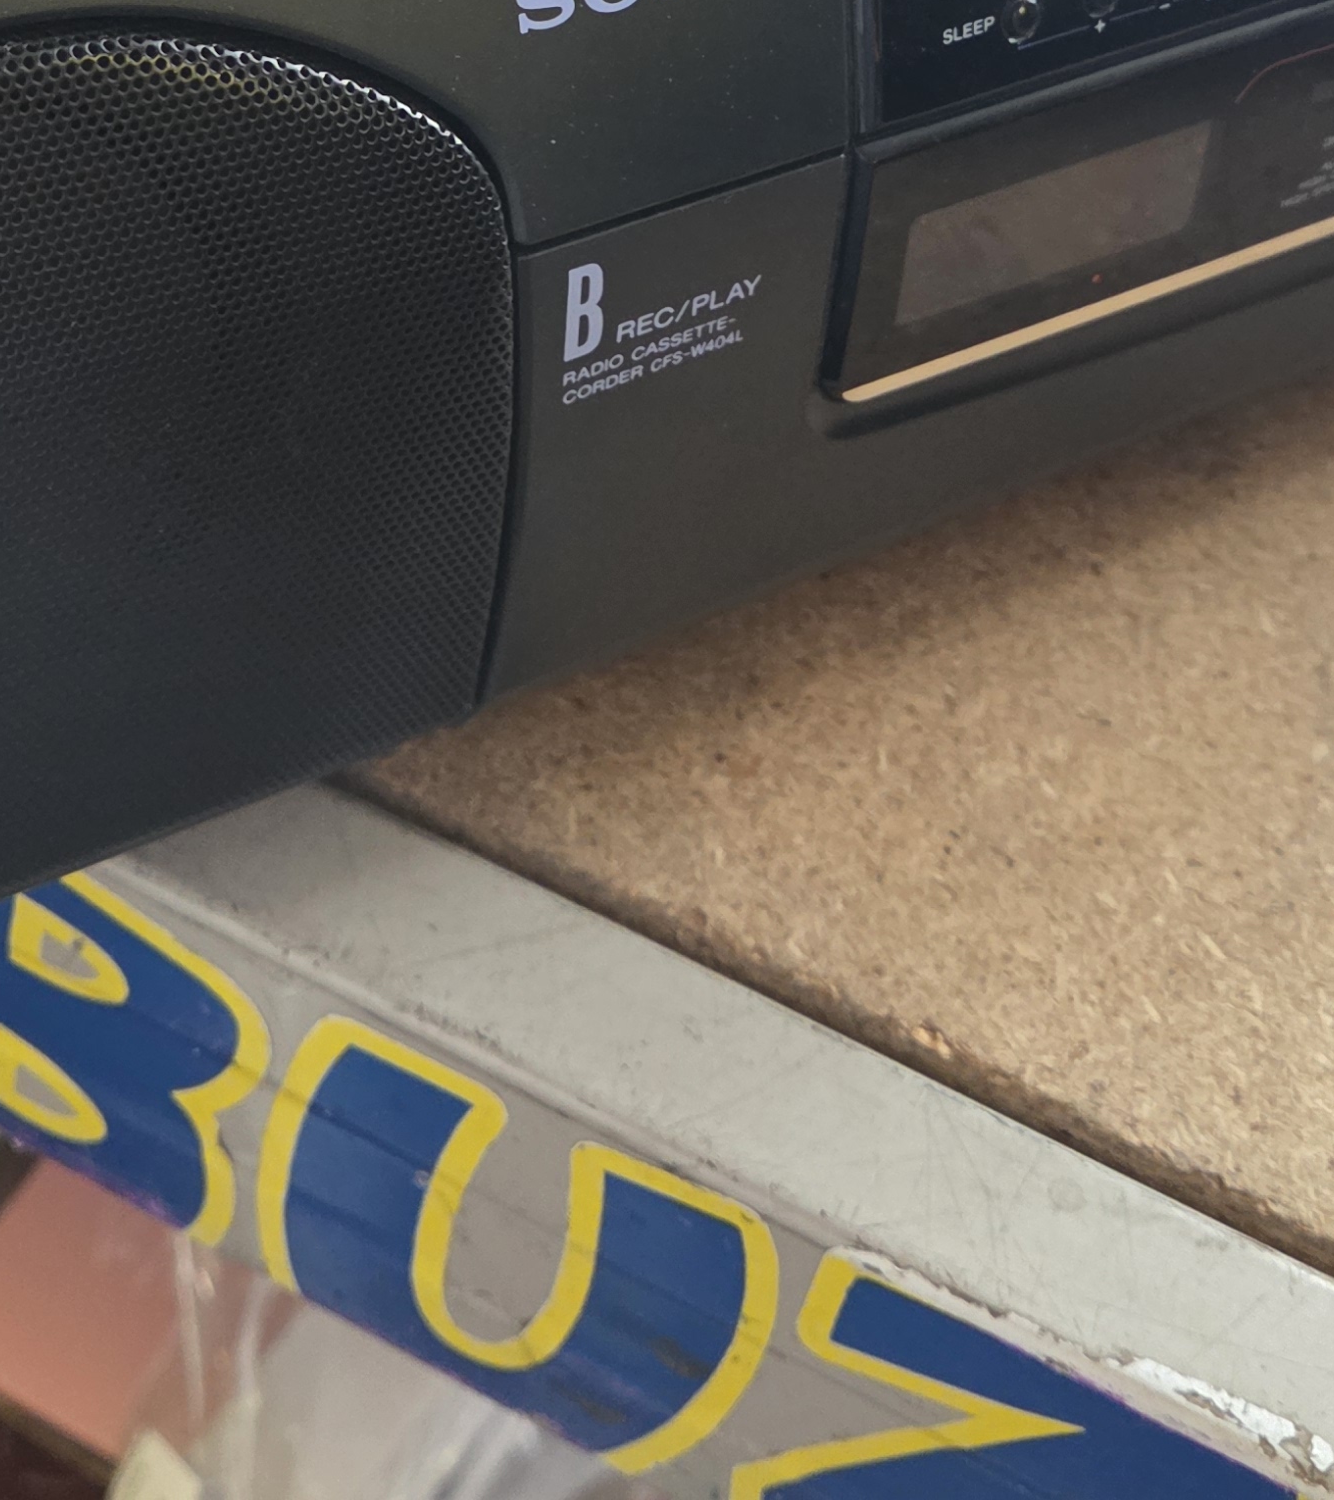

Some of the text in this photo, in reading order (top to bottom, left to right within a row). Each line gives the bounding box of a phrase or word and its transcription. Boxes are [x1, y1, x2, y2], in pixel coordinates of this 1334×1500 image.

[942, 16, 996, 46] SLEEP
[563, 263, 761, 362] B REC/PLAY
[562, 315, 736, 386] RADIO CASSETTE-
[562, 329, 744, 405] CORDER CFS-W404L
